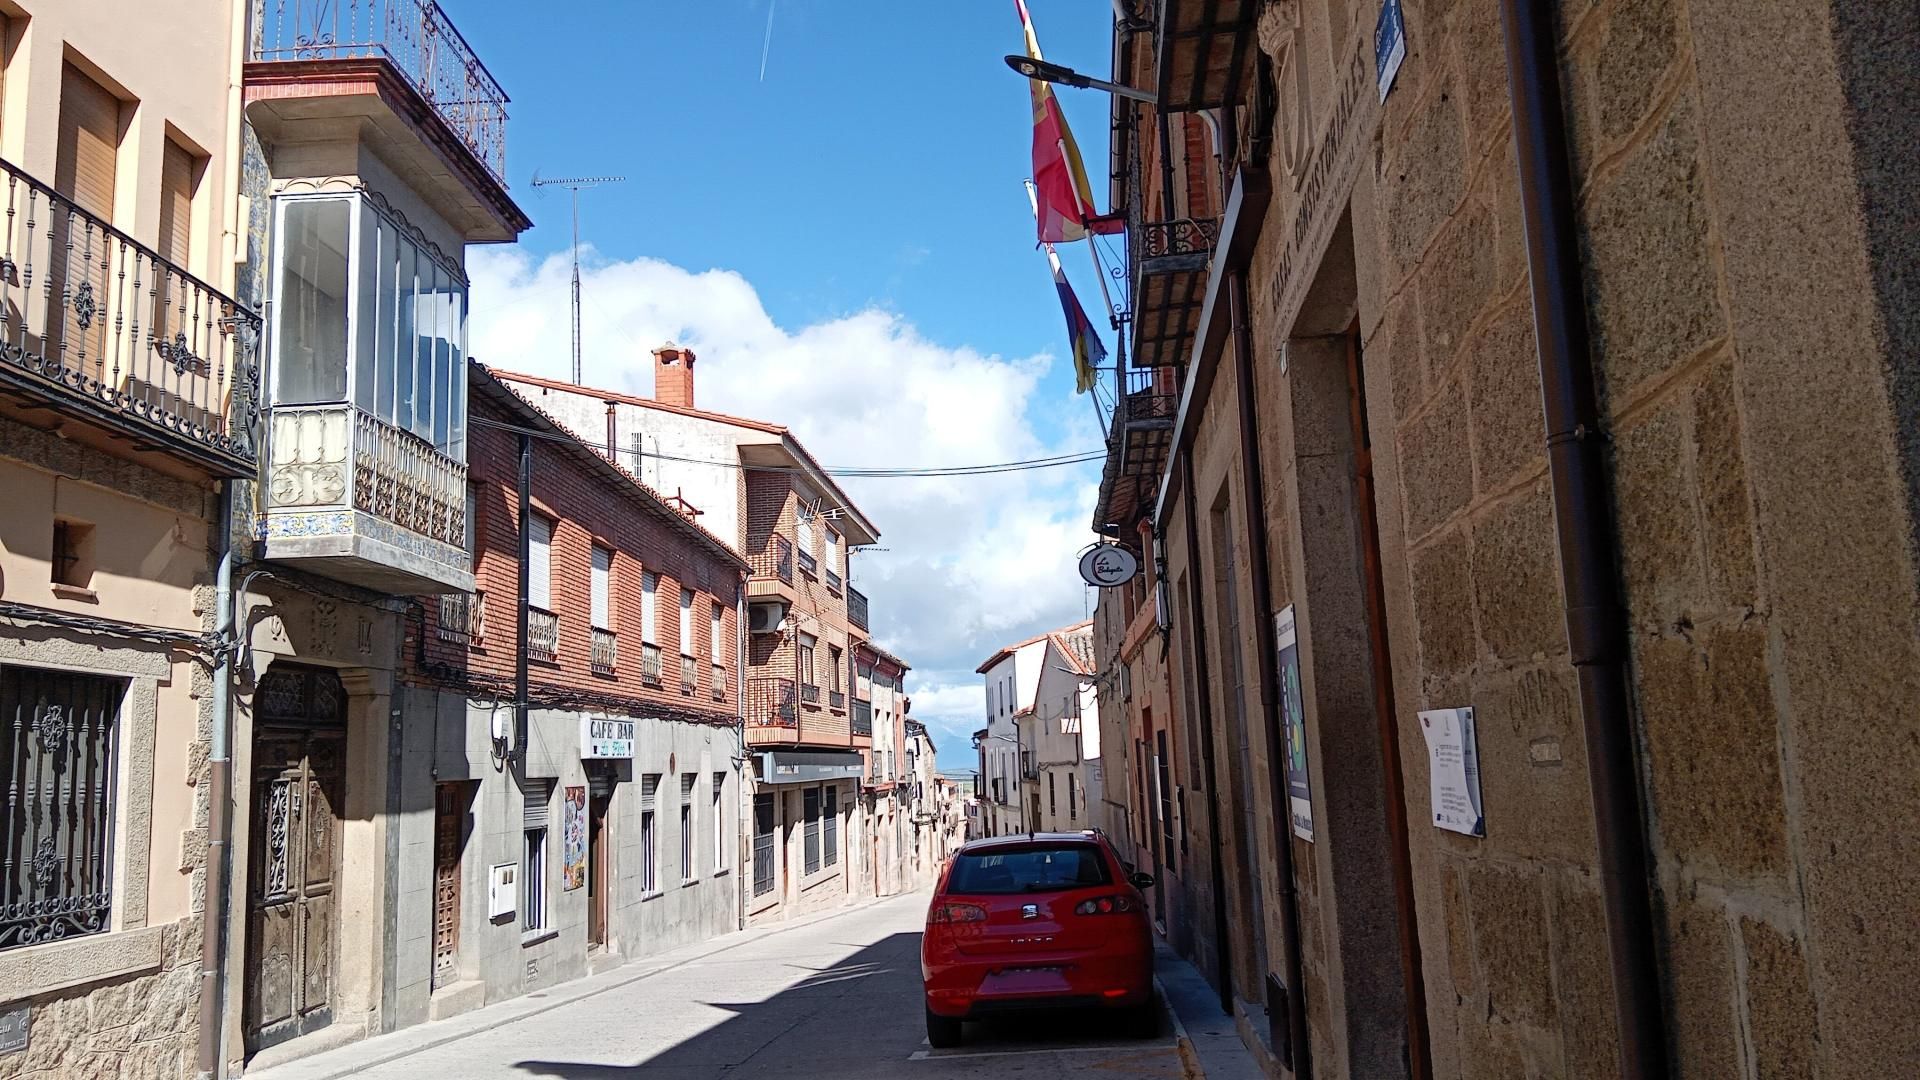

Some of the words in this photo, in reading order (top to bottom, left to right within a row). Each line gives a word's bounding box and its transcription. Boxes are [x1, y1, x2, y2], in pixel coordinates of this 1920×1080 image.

[1271, 241, 1292, 312] CASAS
[591, 721, 613, 739] CAFE
[617, 723, 633, 739] BAR
